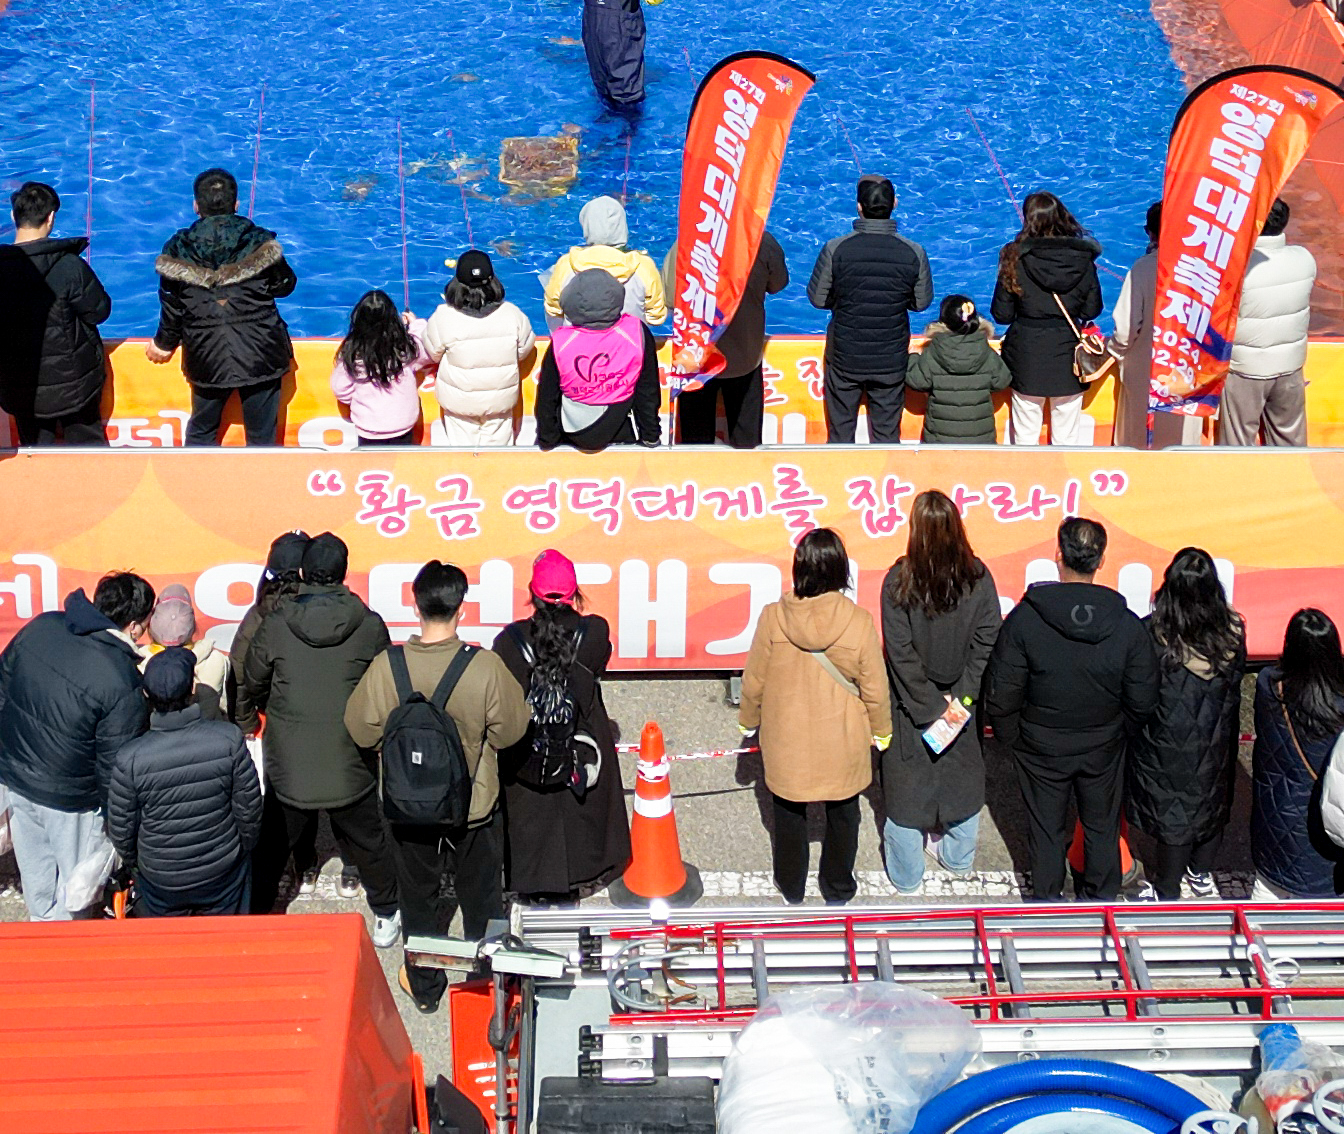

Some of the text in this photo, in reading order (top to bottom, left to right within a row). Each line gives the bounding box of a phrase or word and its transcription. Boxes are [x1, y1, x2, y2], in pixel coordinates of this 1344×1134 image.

[729, 69, 767, 105] 제27회
[1228, 82, 1285, 117] 제27회
[680, 88, 759, 327] 영덕대게축제
[1159, 101, 1276, 345] 영덕대게축제
[504, 464, 826, 547] 영덕대게를
